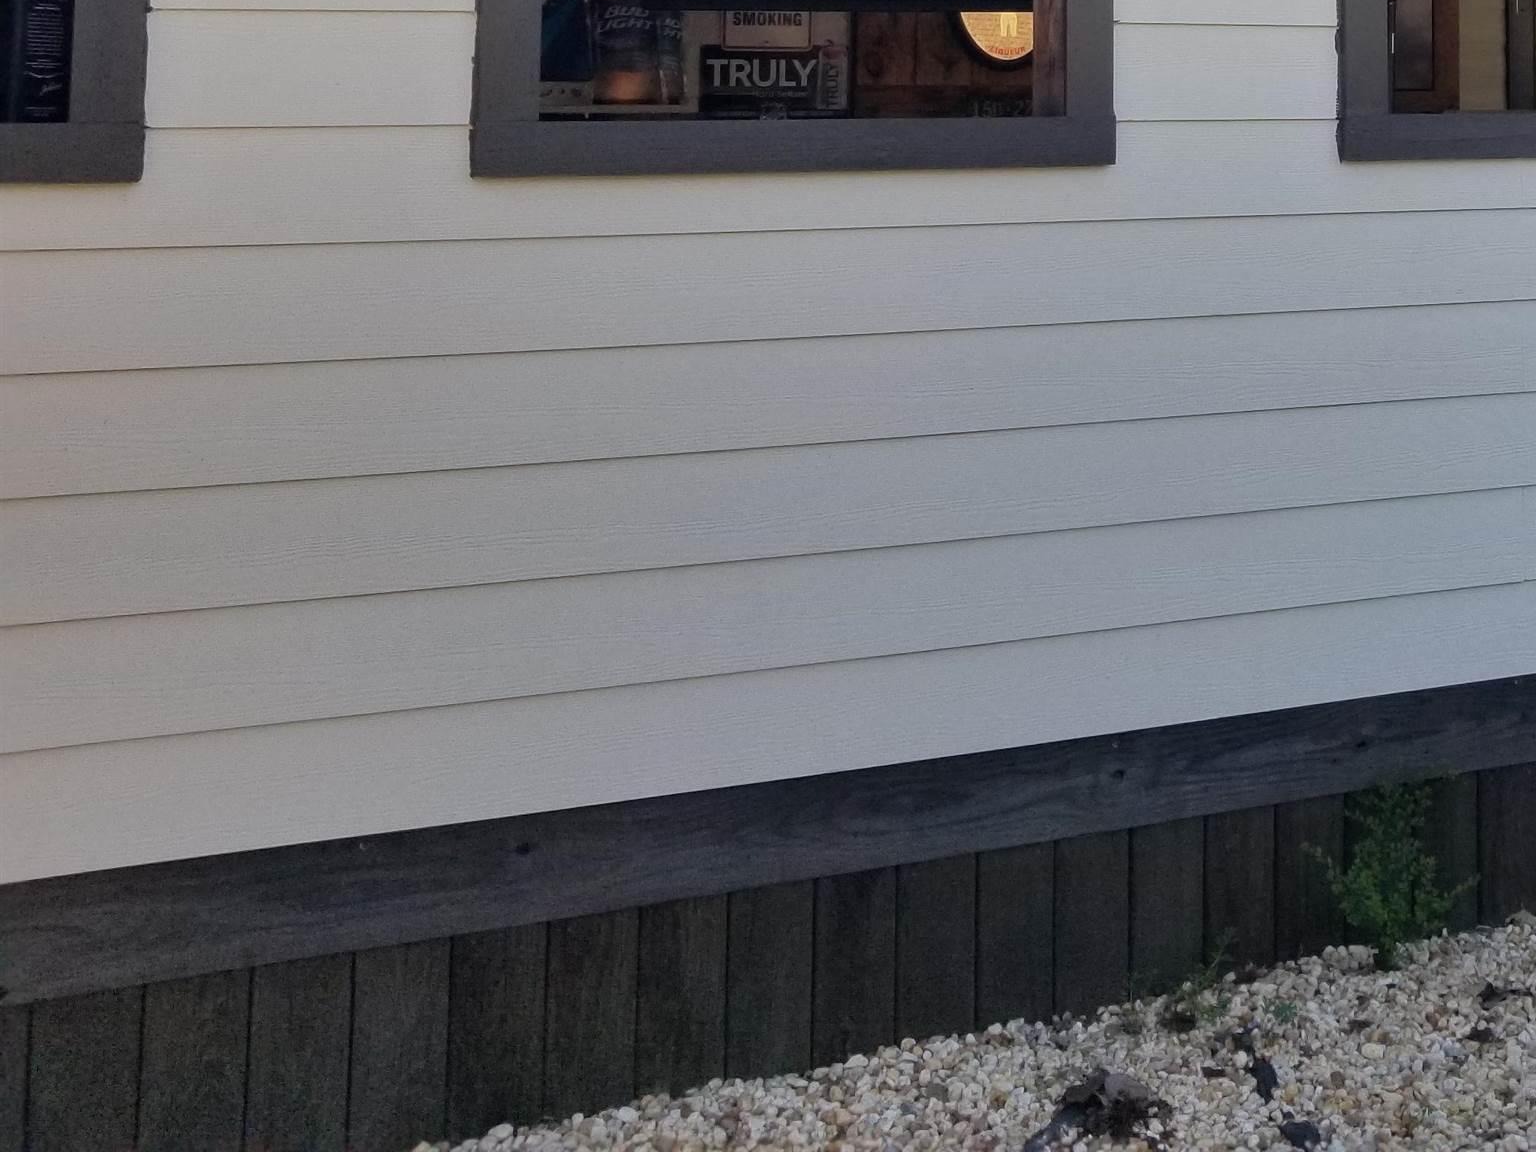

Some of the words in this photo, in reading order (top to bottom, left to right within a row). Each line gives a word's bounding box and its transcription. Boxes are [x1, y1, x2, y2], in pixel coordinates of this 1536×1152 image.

[597, 17, 654, 33] LIGHT
[733, 12, 802, 26] SMOKING
[706, 59, 817, 88] TRULY
